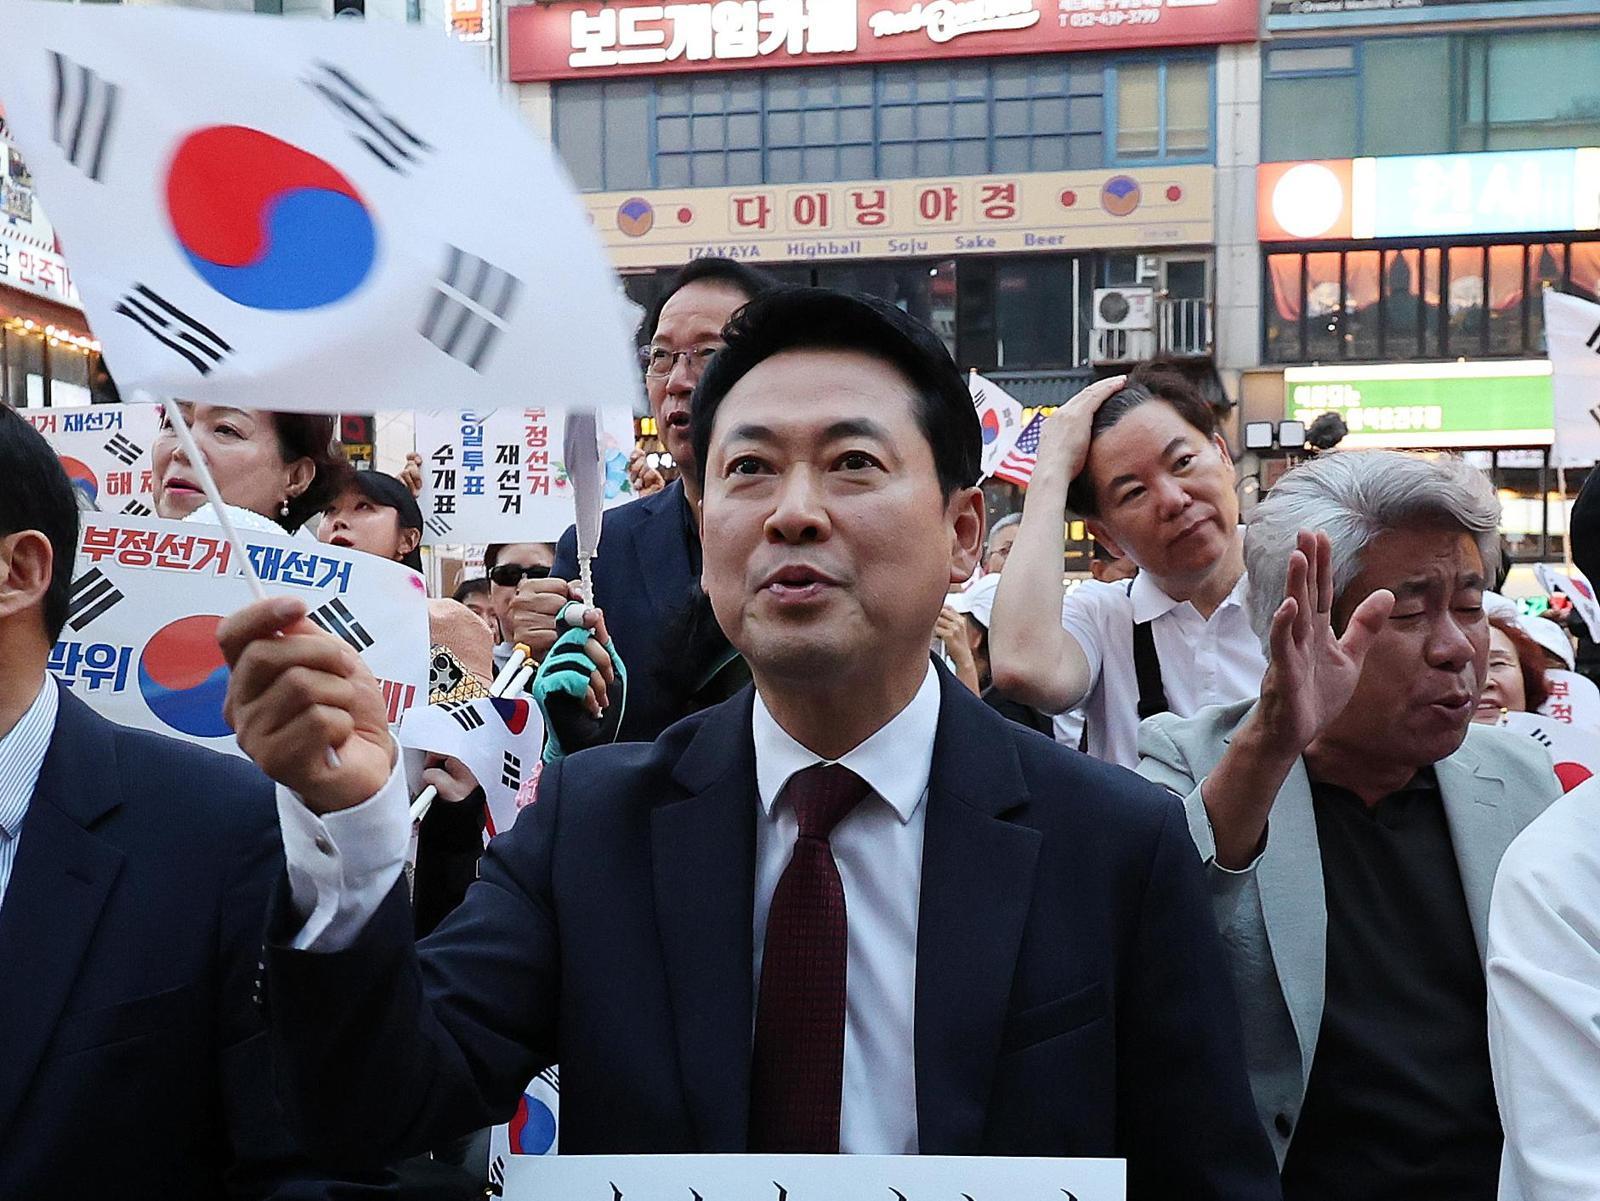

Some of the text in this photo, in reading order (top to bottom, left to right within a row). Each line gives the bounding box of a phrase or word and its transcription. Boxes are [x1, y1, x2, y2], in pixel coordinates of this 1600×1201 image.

[733, 183, 1016, 229] 다이닝 야경
[688, 232, 1066, 259] IZAKAYA Highball Soju Sake Beer
[63, 411, 123, 432] 재선거
[431, 444, 456, 514] 수개표
[495, 444, 521, 514] 재선거
[82, 526, 353, 593] 부정선거 재선거
